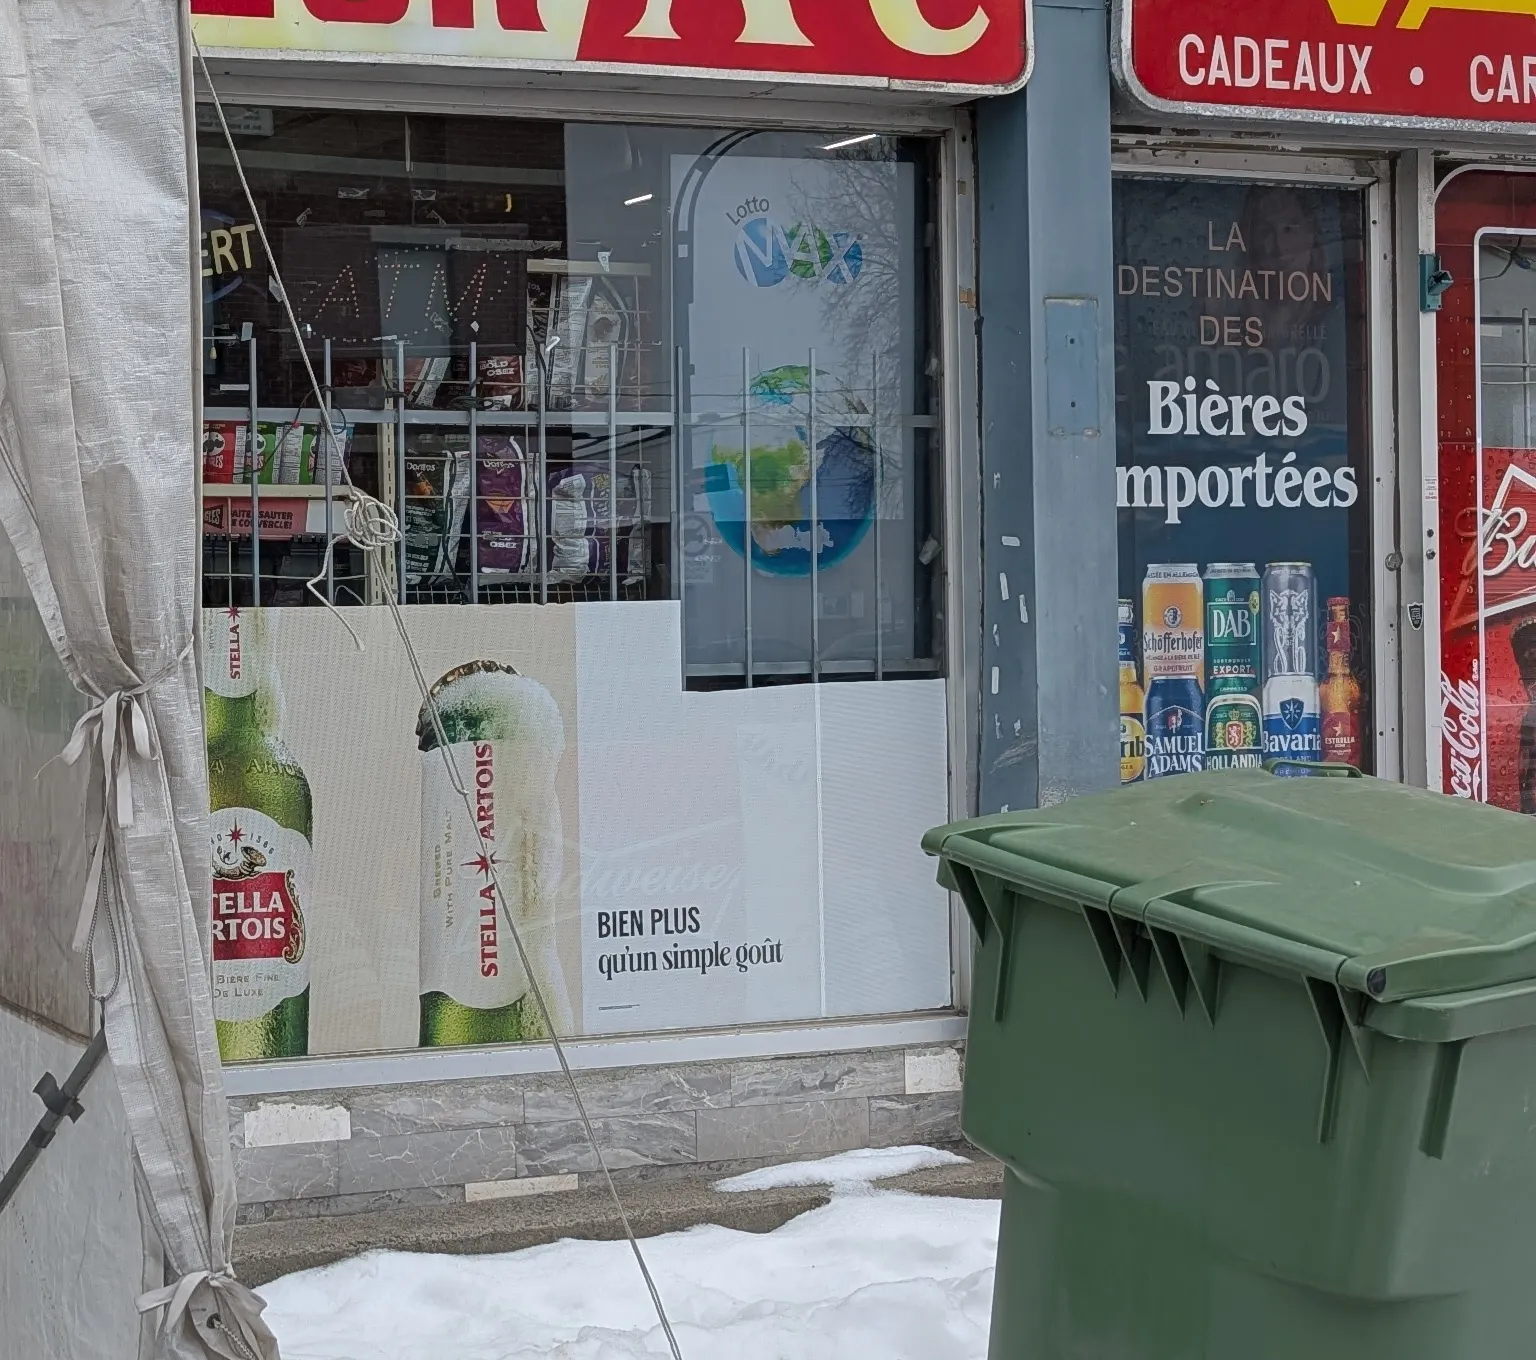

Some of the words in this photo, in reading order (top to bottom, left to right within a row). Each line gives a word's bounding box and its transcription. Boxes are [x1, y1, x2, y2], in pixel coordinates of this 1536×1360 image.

[1178, 33, 1373, 95] CADEAUX
[725, 195, 771, 226] Lotto
[734, 217, 863, 288] MAX
[1208, 221, 1247, 252] LA
[314, 263, 487, 319] ATM
[1118, 264, 1332, 302] DESTINATION
[1200, 315, 1264, 347] DES
[1146, 375, 1309, 438] Bières
[258, 510, 294, 520] SAUTER
[1213, 609, 1251, 639] DAB
[228, 623, 242, 680] STELLA
[1213, 664, 1251, 675] EXPORT
[1144, 732, 1206, 756] SAMUEL
[1148, 755, 1203, 778] ADAMS
[1206, 753, 1263, 771] HOLLANDIA
[474, 741, 496, 842] ARTOIS
[478, 882, 499, 978] STELLA
[597, 909, 644, 939] BIEN
[650, 906, 701, 936] PLUS
[598, 945, 657, 981] qu'un
[661, 940, 732, 975] simple
[735, 937, 784, 973] goût
